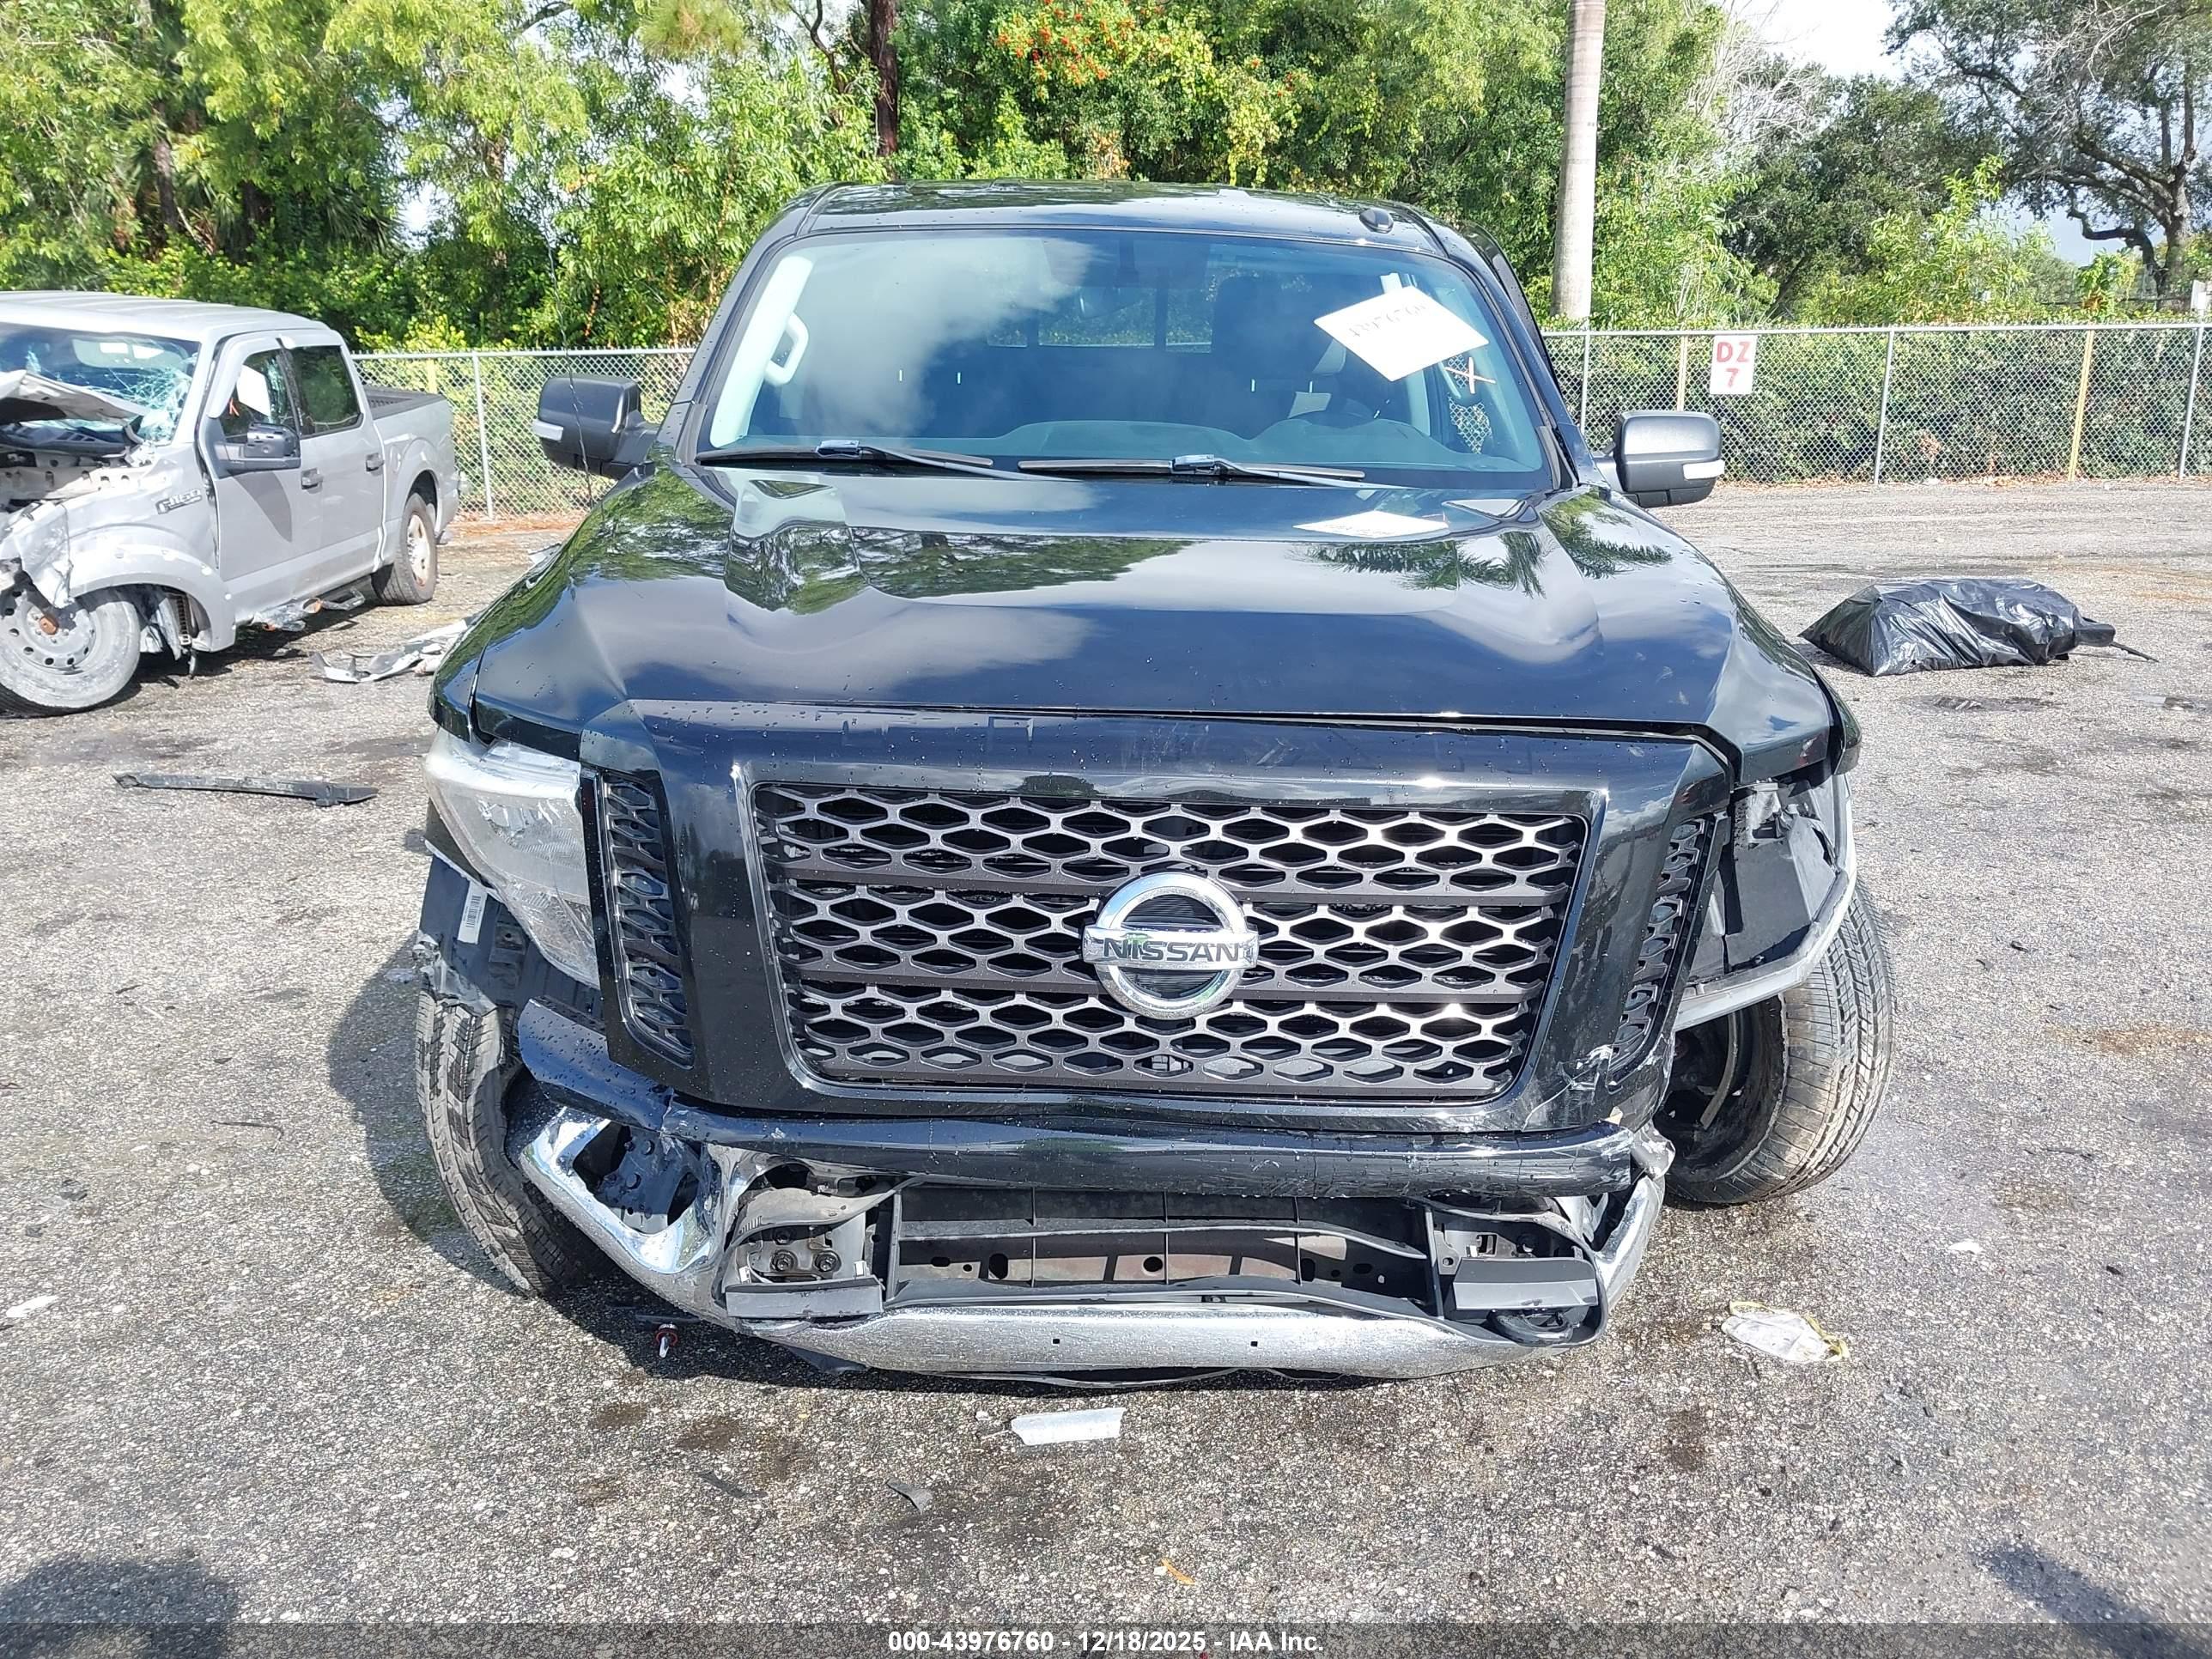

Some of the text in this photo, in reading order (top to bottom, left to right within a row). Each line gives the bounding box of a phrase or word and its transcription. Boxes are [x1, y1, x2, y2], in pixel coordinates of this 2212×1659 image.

[1716, 341, 1752, 363] DZ
[1725, 367, 1740, 388] 7
[1103, 937, 1239, 963] NISSAN
